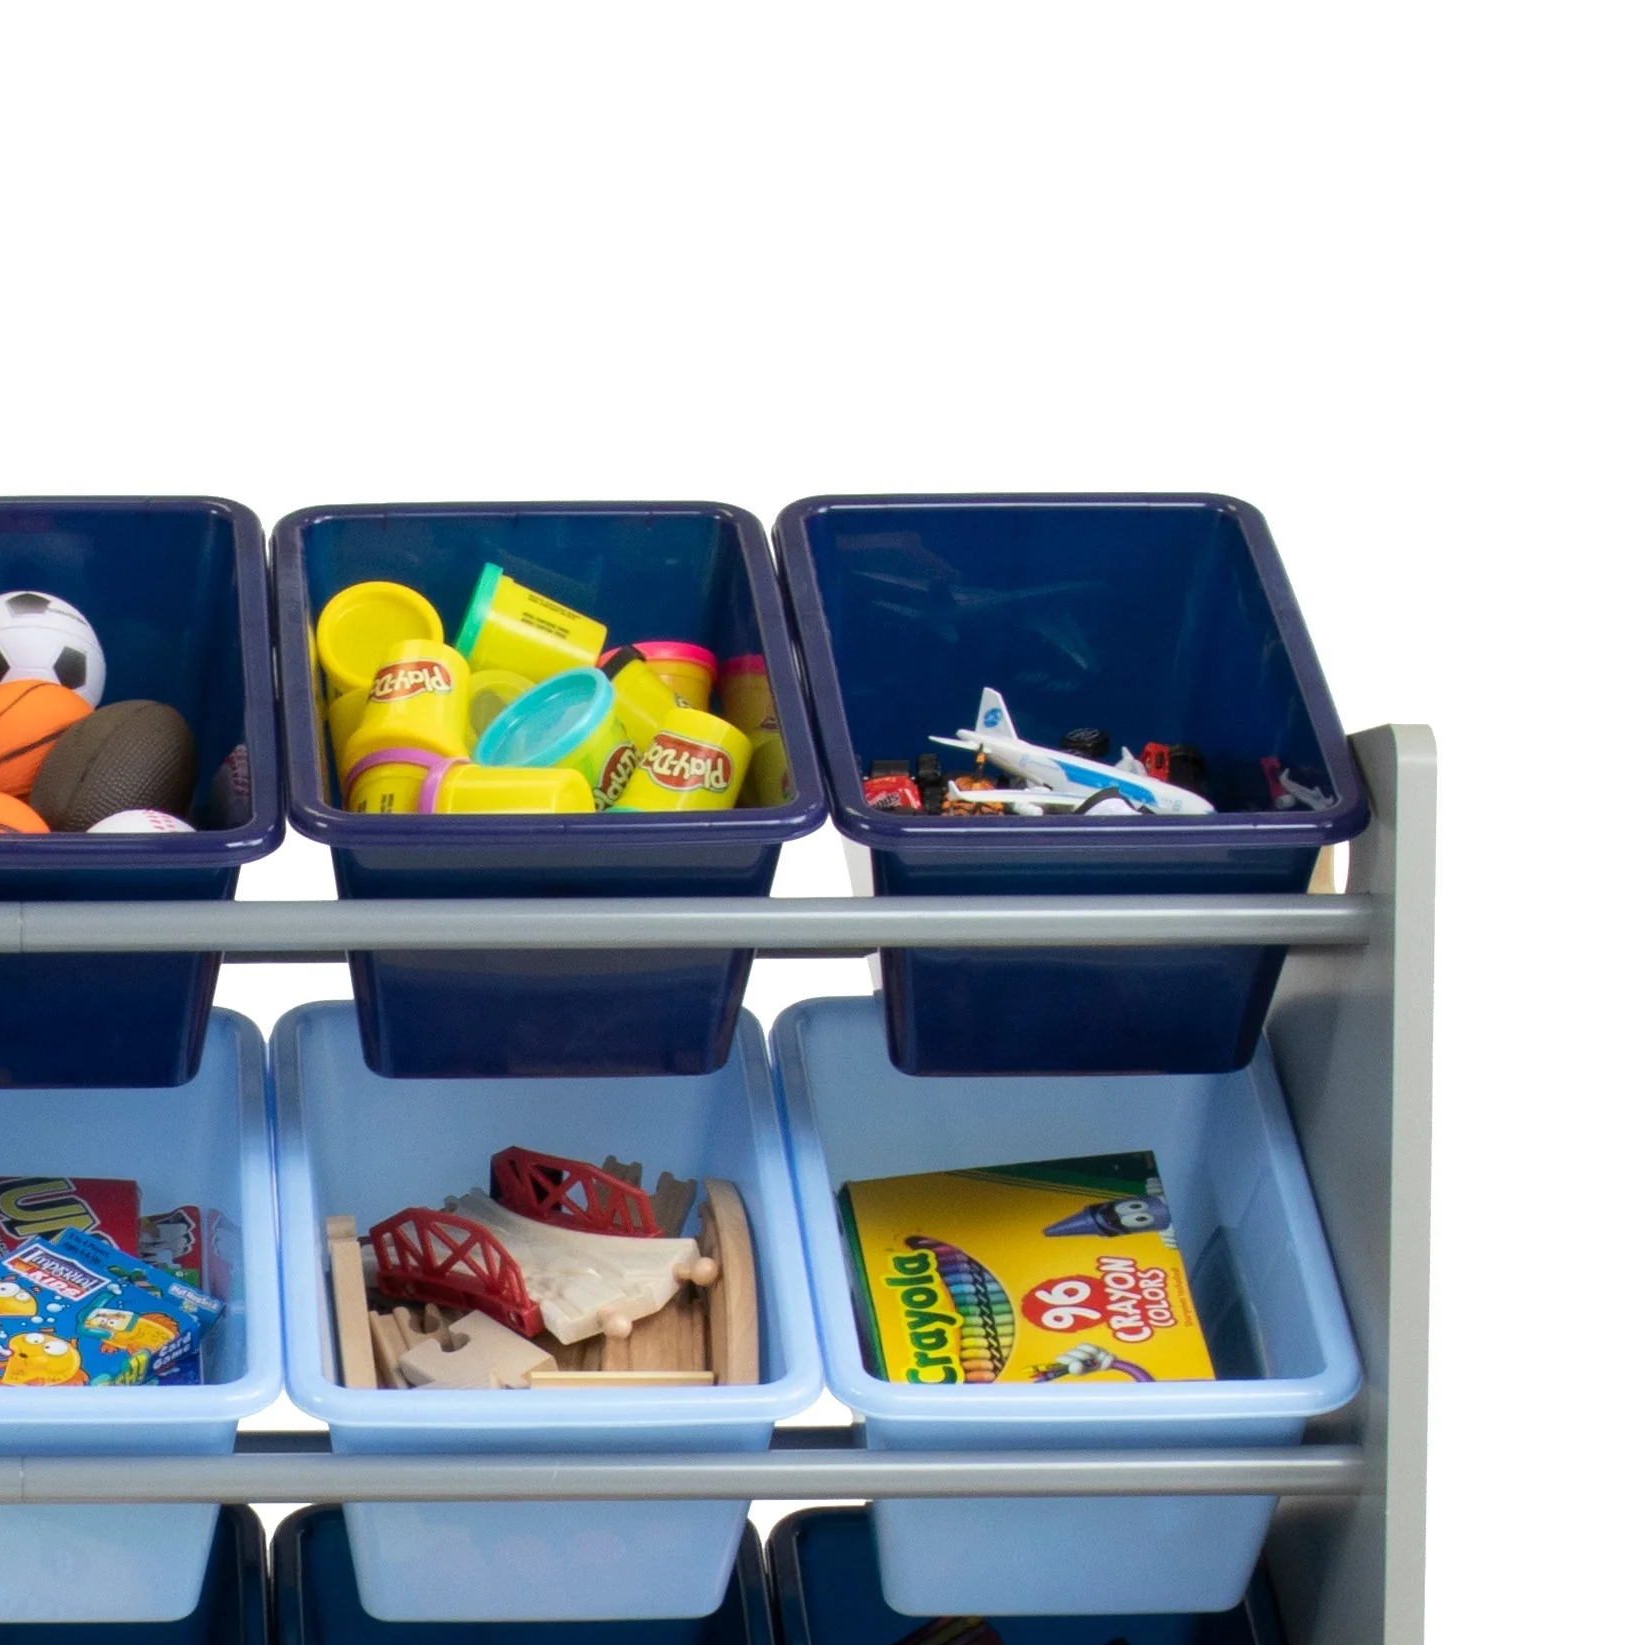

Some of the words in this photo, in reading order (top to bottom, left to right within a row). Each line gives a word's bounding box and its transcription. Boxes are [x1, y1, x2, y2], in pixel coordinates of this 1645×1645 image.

[641, 743, 728, 790] Play-Do
[28, 1268, 82, 1298] KIDS
[1040, 1279, 1103, 1331] 96
[1099, 1257, 1150, 1342] CRAYON
[1137, 1269, 1175, 1327] COLORS
[886, 1250, 957, 1384] Crayola
